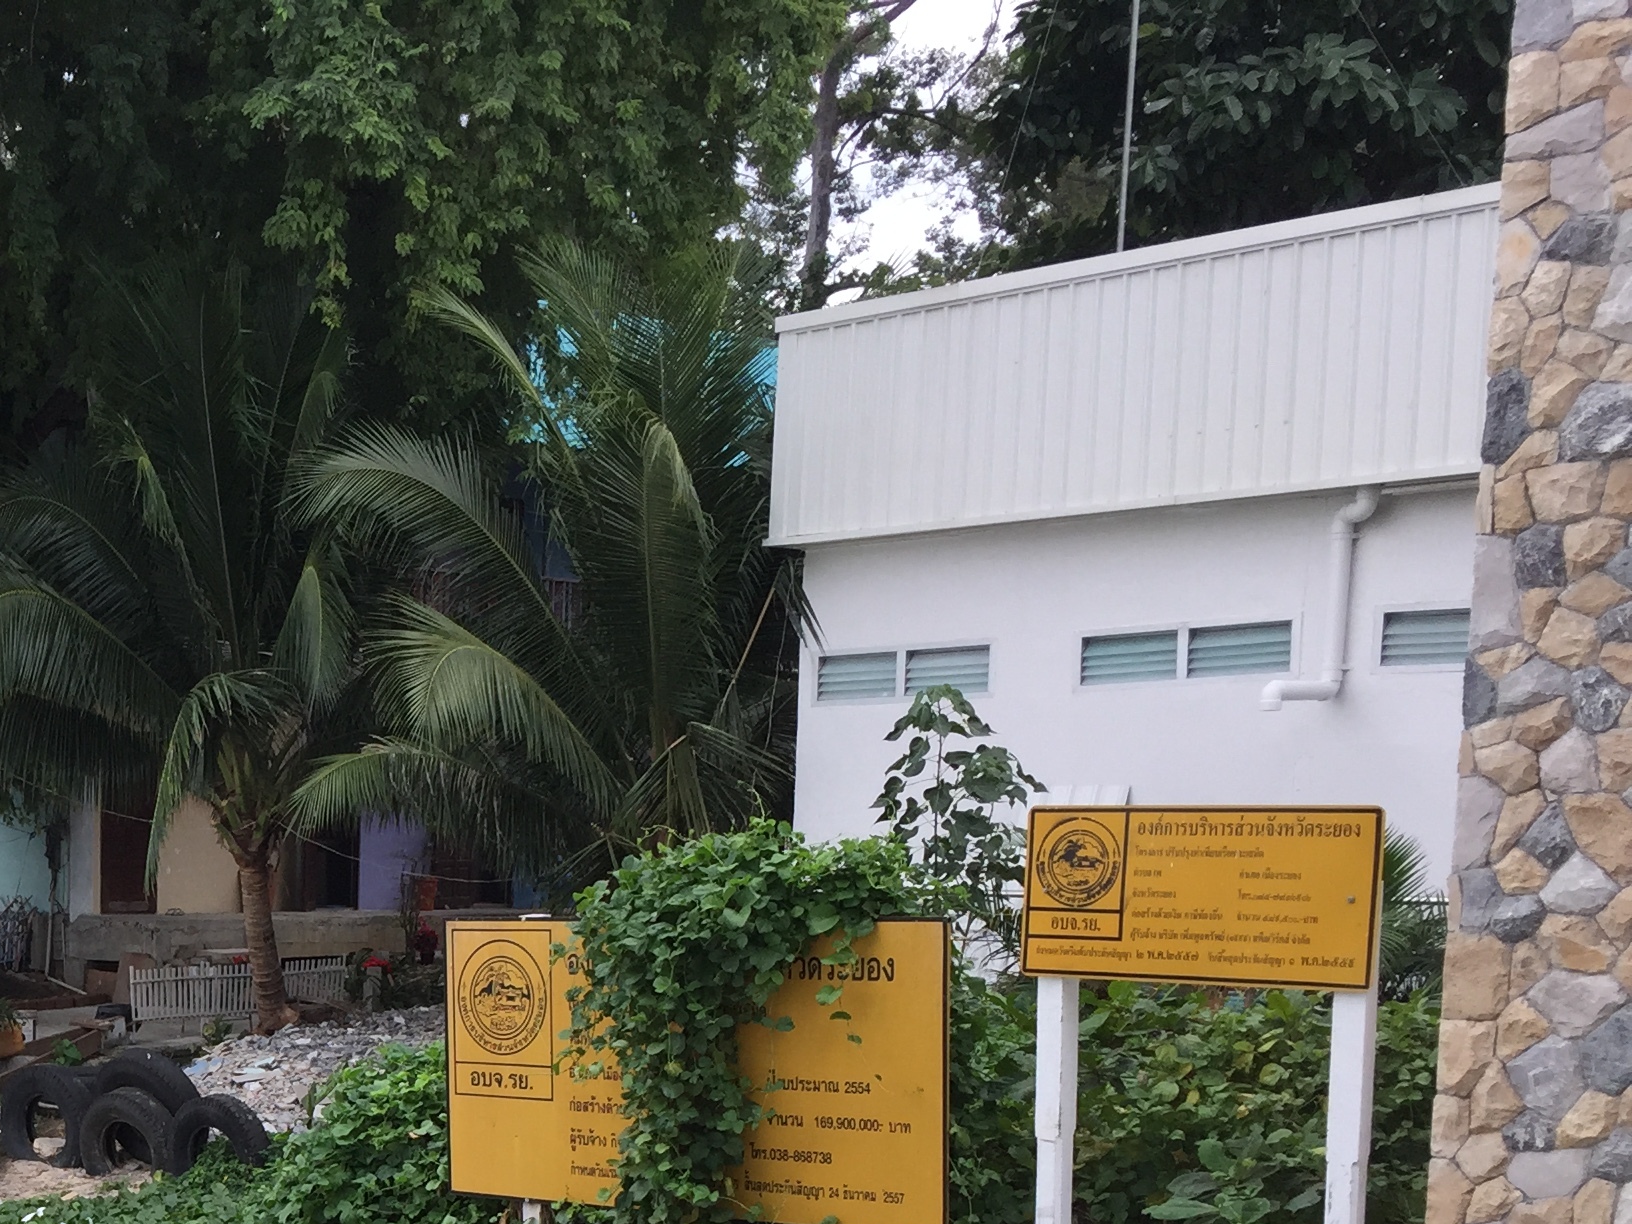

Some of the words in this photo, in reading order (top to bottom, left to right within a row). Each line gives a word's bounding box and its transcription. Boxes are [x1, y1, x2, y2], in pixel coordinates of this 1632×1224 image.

[1137, 813, 1361, 838] องค์การบริหารส่วนจังหวัดระยอง
[1051, 916, 1101, 932] อบจ.รย.
[470, 1070, 534, 1091] อบจ.รย.
[843, 1080, 872, 1095] 2554
[888, 1121, 912, 1135] บาท
[569, 1127, 608, 1152] ผู้รับจ้าง
[743, 1169, 826, 1202] สิ้นสุดประกันสัญญา
[828, 1186, 840, 1199] 24
[842, 1183, 877, 1203] ธันวาคม
[882, 1190, 906, 1205] 2557
